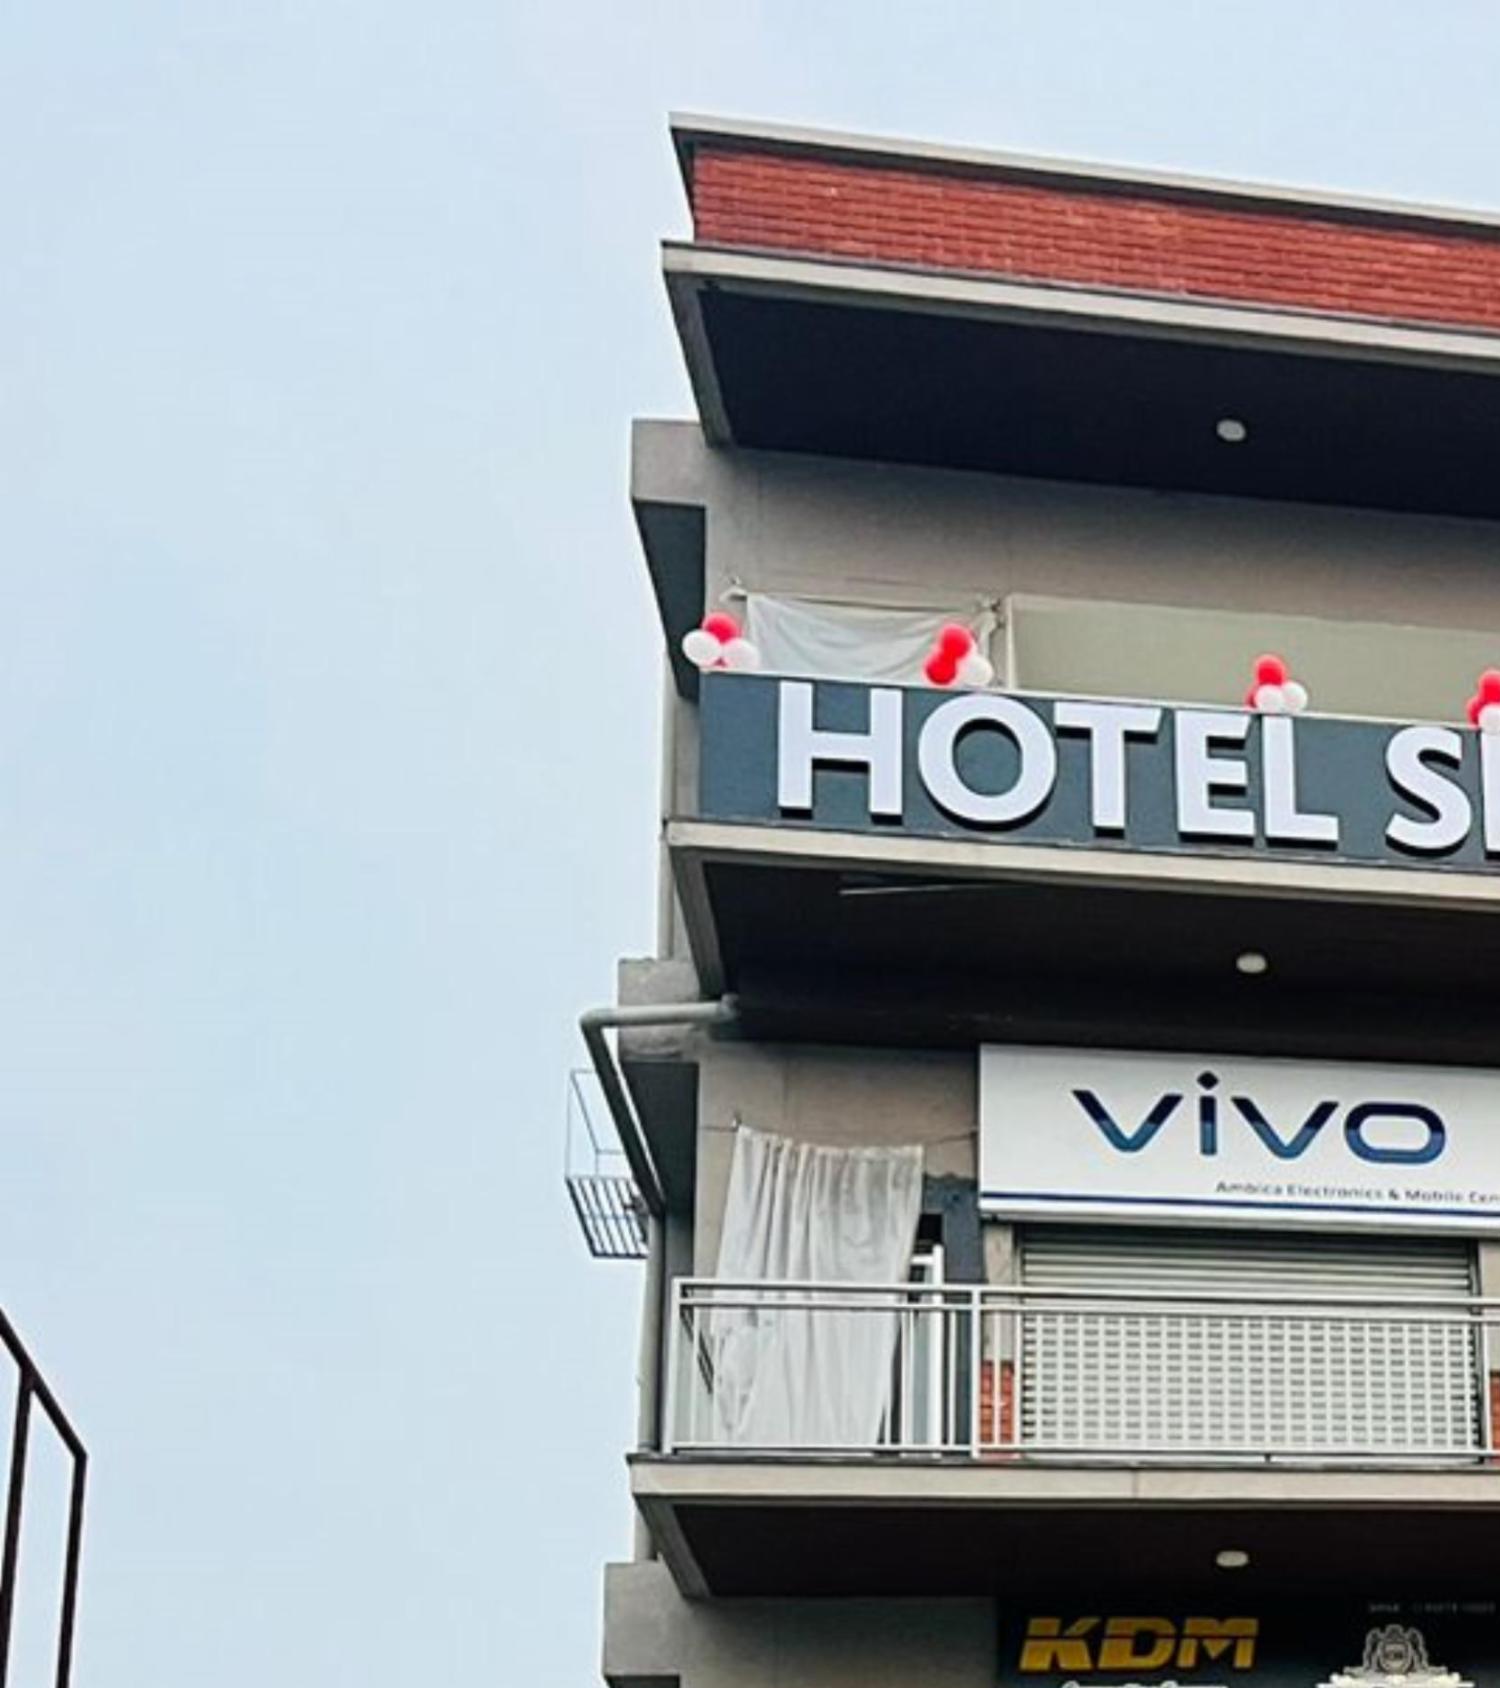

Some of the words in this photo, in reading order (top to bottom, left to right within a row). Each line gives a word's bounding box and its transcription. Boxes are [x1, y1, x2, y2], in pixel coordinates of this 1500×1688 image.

[777, 679, 1338, 846] HOTEL
[1072, 1071, 1447, 1165] vivo
[1215, 1180, 1282, 1196] Ambica
[1287, 1184, 1383, 1201] Electronics
[1388, 1188, 1400, 1201] &
[1405, 1189, 1464, 1204] Mobile
[1019, 1617, 1260, 1672] KDM
